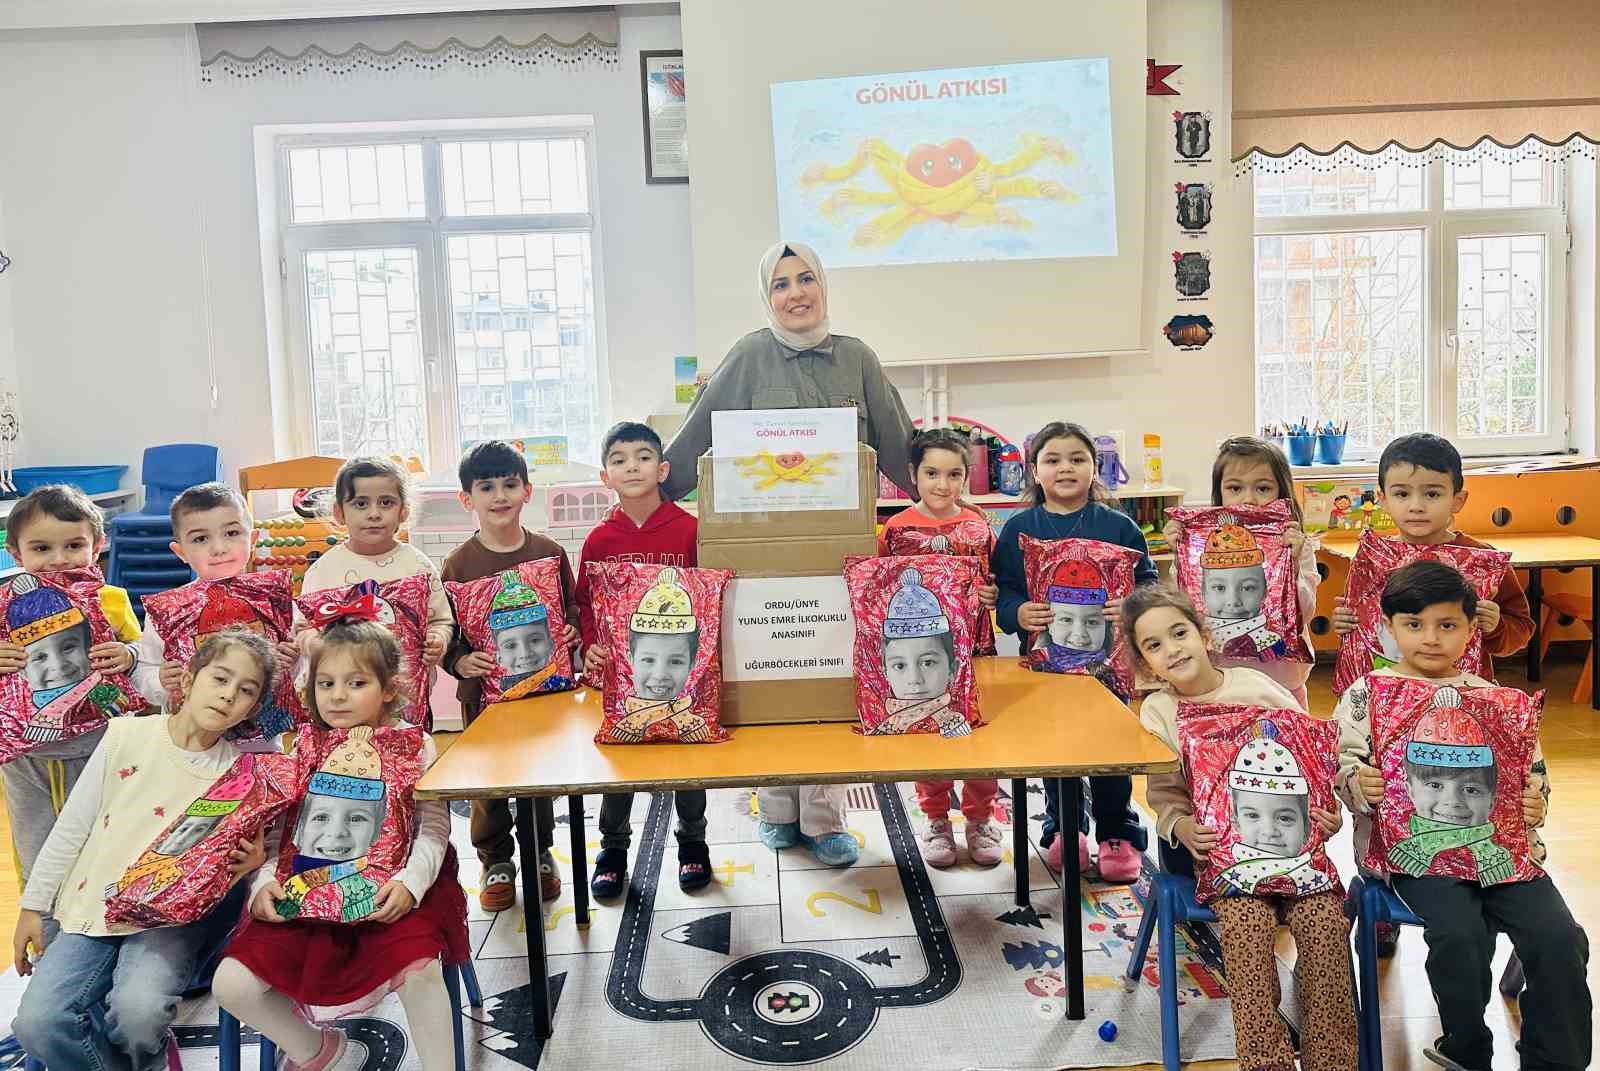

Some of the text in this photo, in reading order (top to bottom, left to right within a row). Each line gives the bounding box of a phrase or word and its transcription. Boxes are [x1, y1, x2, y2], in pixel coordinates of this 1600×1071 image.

[856, 78, 1007, 105] GÖNÜL ATKISI
[765, 599, 819, 610] ORDU/ÜNYE
[738, 616, 769, 626] YUNUS
[771, 615, 796, 625] EMRE
[771, 629, 815, 640] ANASINIFI
[745, 658, 844, 670] UĞURBÖCEKLERİ SINIFI
